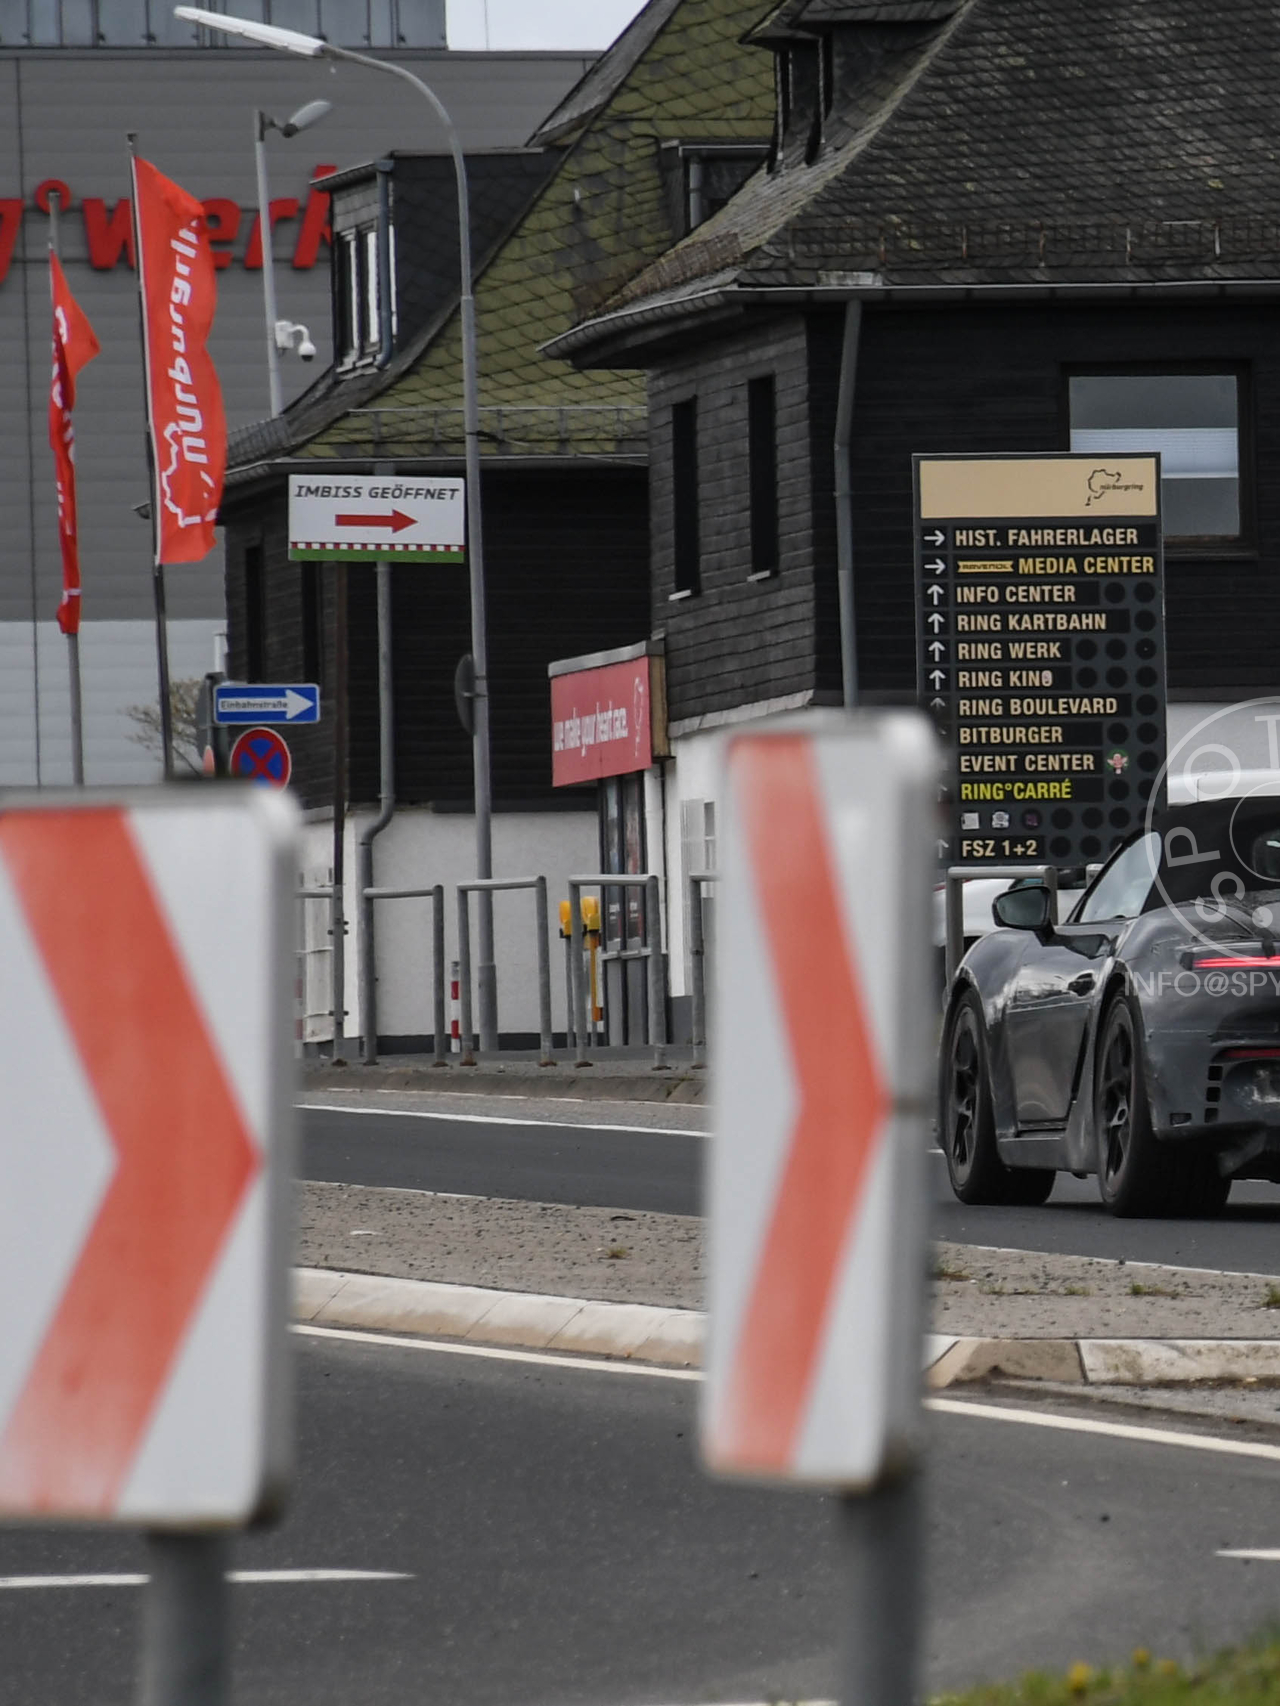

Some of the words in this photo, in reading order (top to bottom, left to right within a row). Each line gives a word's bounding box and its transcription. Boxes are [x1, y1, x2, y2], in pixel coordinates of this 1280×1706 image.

[295, 485, 363, 498] IMBISS
[368, 484, 459, 500] GEÖFFNET
[955, 529, 1001, 546] HIST.
[1008, 528, 1138, 546] FAHRERLAGER
[1018, 557, 1078, 574] MEDIA
[1083, 556, 1155, 574] CENTER
[956, 586, 999, 603] INFO
[1005, 585, 1076, 602] CENTER
[957, 614, 1001, 631] RING
[1008, 613, 1107, 630] KARTBAHN
[958, 643, 1002, 660] RING
[1009, 642, 1062, 659] WERK
[958, 671, 1003, 688] RING
[221, 700, 288, 709] Einbahnstraße
[959, 699, 1003, 716] RING
[1010, 698, 1118, 715] BOULEVARD
[959, 726, 1063, 744] BITBURGER
[960, 755, 1018, 772] EVENT
[1025, 754, 1095, 772] CENTER
[961, 778, 1072, 800] RING°CARRÉ
[962, 840, 996, 857] FSZ
[1002, 839, 1038, 856] 1+2
